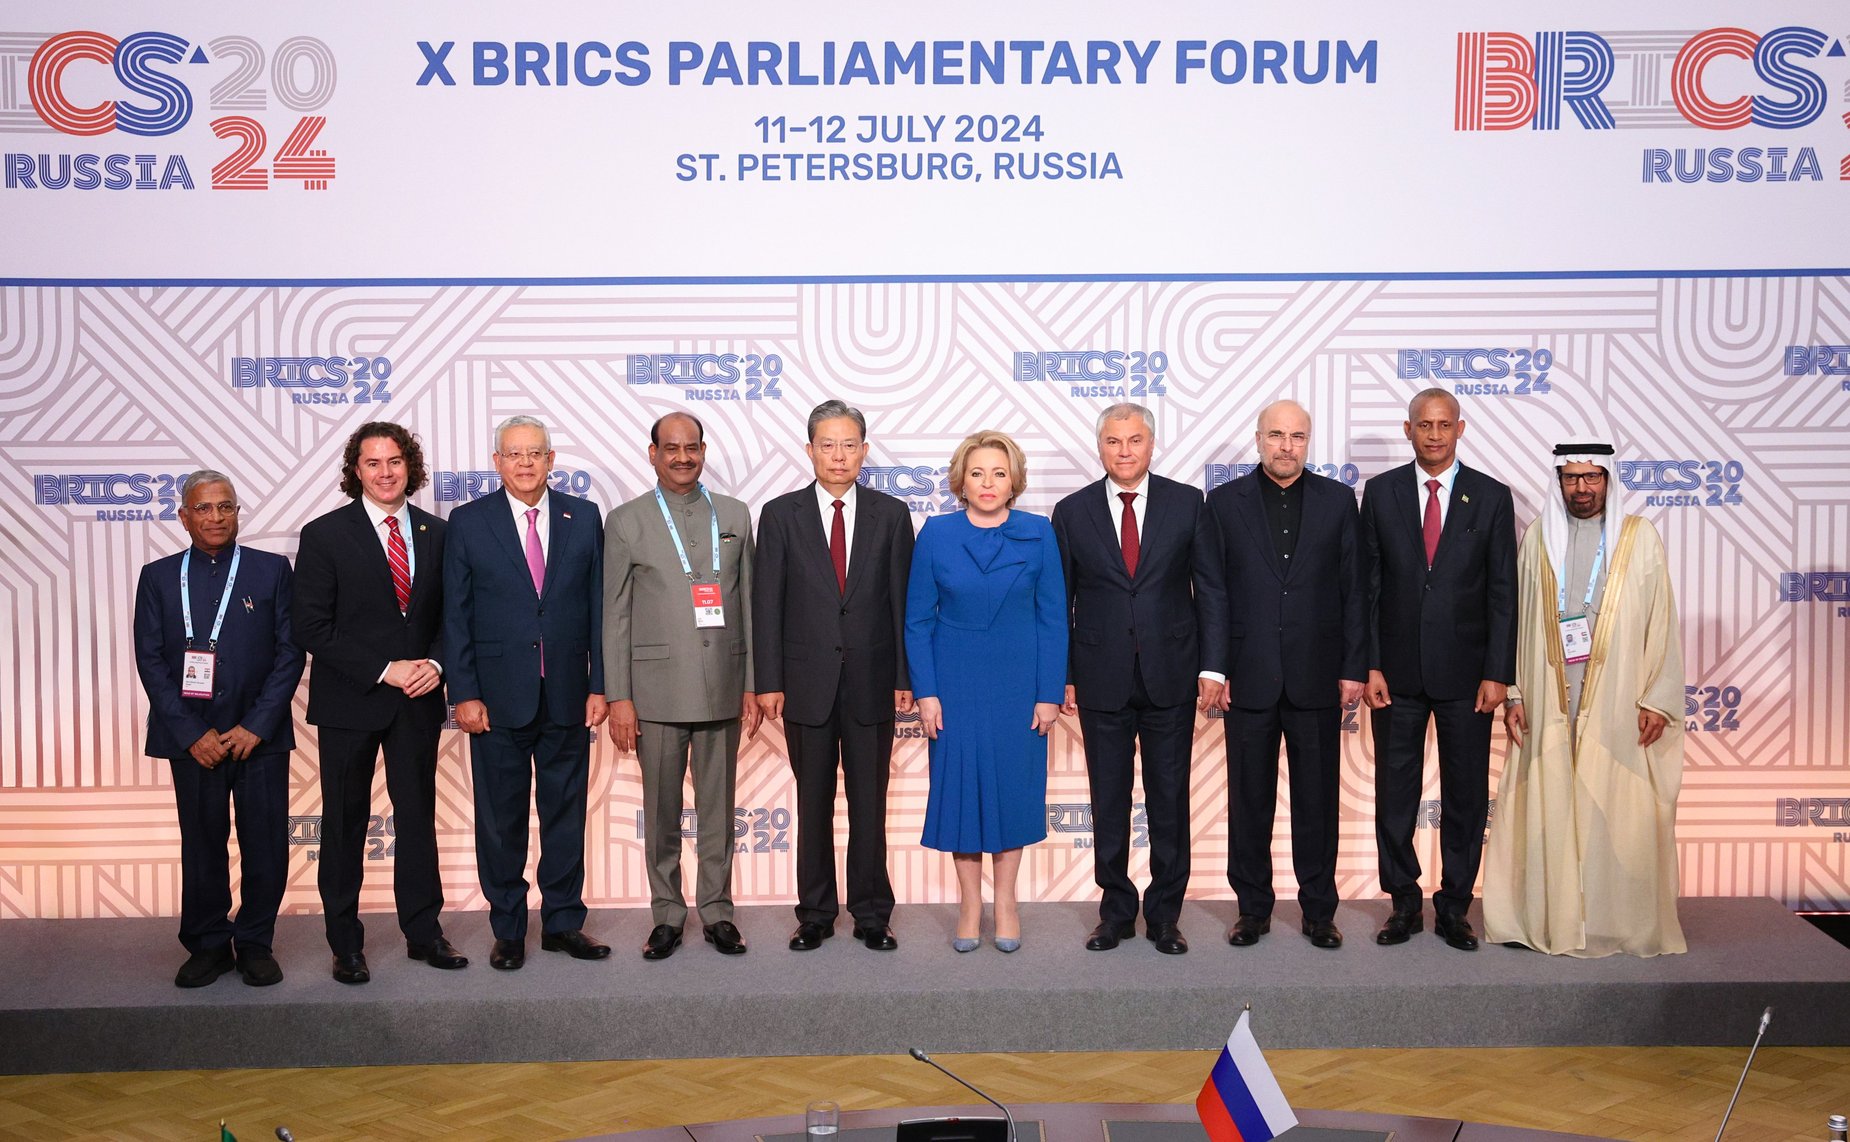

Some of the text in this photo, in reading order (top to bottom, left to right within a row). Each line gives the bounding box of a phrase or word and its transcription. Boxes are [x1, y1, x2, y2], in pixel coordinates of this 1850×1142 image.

[416, 40, 1378, 87] X BRICS PARLIAMENTARY FORUM
[1454, 26, 1828, 130] BRICS
[0, 30, 337, 136] ICS 20
[857, 115, 946, 143] JULY
[955, 114, 1045, 142] 2024
[4, 115, 336, 190] RUSSIA 24
[1642, 147, 1823, 183] RUSSIA
[675, 152, 1123, 183] ST. PETERSBURG, RUSSIA
[231, 356, 392, 388] BRICS 20
[626, 353, 783, 385] BRICS 20
[1013, 350, 1168, 382] BRICS 20
[1397, 348, 1553, 379] BRICS 20
[1784, 345, 1850, 375] BRI
[291, 381, 391, 404] RUSSIA 24
[684, 378, 782, 401] RUSSIA 24
[1070, 375, 1167, 397] RUSSIA 24
[1454, 372, 1551, 395] RUSSIA 24
[34, 473, 153, 505] BRICS
[433, 471, 502, 501] BRI
[1615, 460, 1744, 491] RICS 20
[96, 498, 177, 521] RUSSIA 2
[909, 501, 935, 512] SIA
[1646, 484, 1743, 506] RUSSIA 24
[1780, 572, 1850, 601] BRI
[1704, 686, 1742, 708] 20
[895, 727, 928, 738] USS
[1704, 709, 1740, 731] 24
[753, 807, 791, 830] 20
[1133, 803, 1148, 825] 2
[1776, 797, 1850, 827] BRI
[753, 831, 790, 853] 24
[1133, 826, 1149, 848] 2
